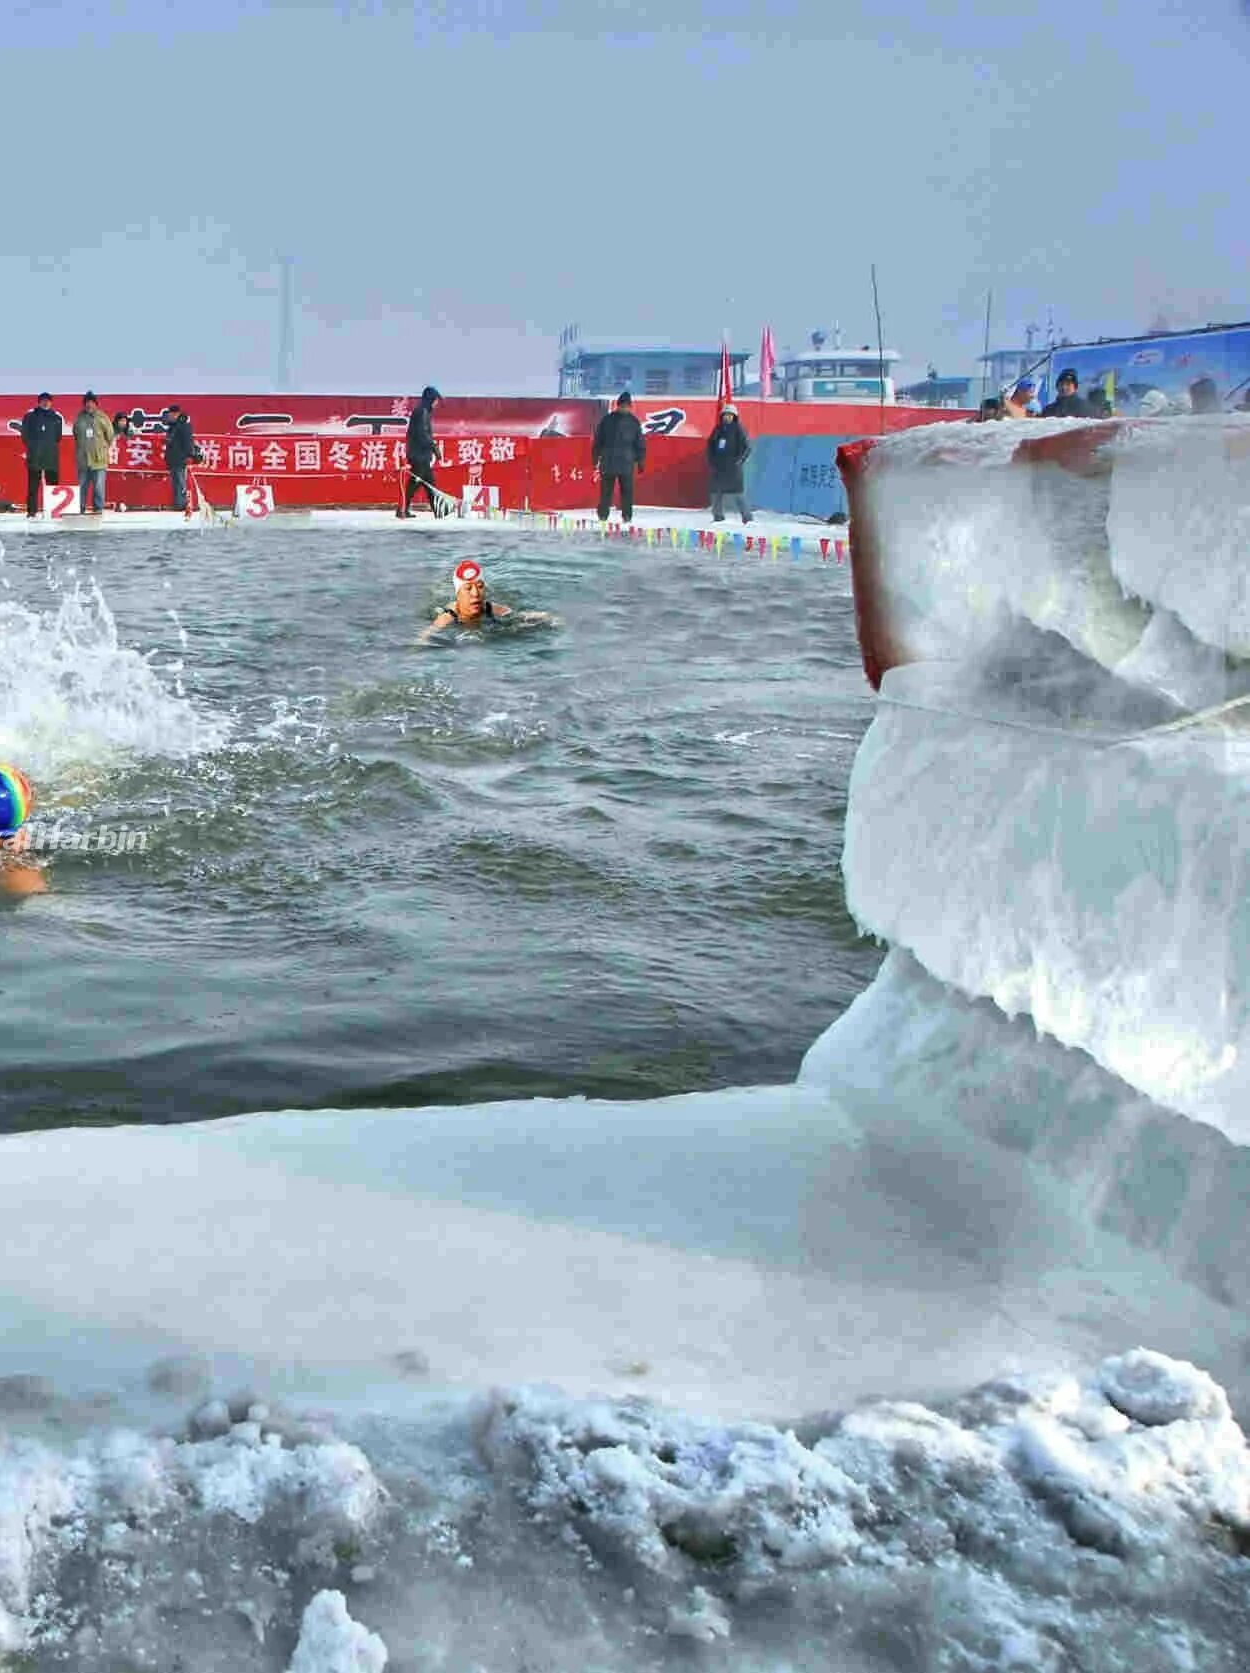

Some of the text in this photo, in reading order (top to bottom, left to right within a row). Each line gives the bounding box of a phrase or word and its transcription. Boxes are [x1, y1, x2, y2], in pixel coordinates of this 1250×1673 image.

[50, 486, 76, 518] 2
[244, 487, 269, 518] 3
[469, 486, 492, 518] 4
